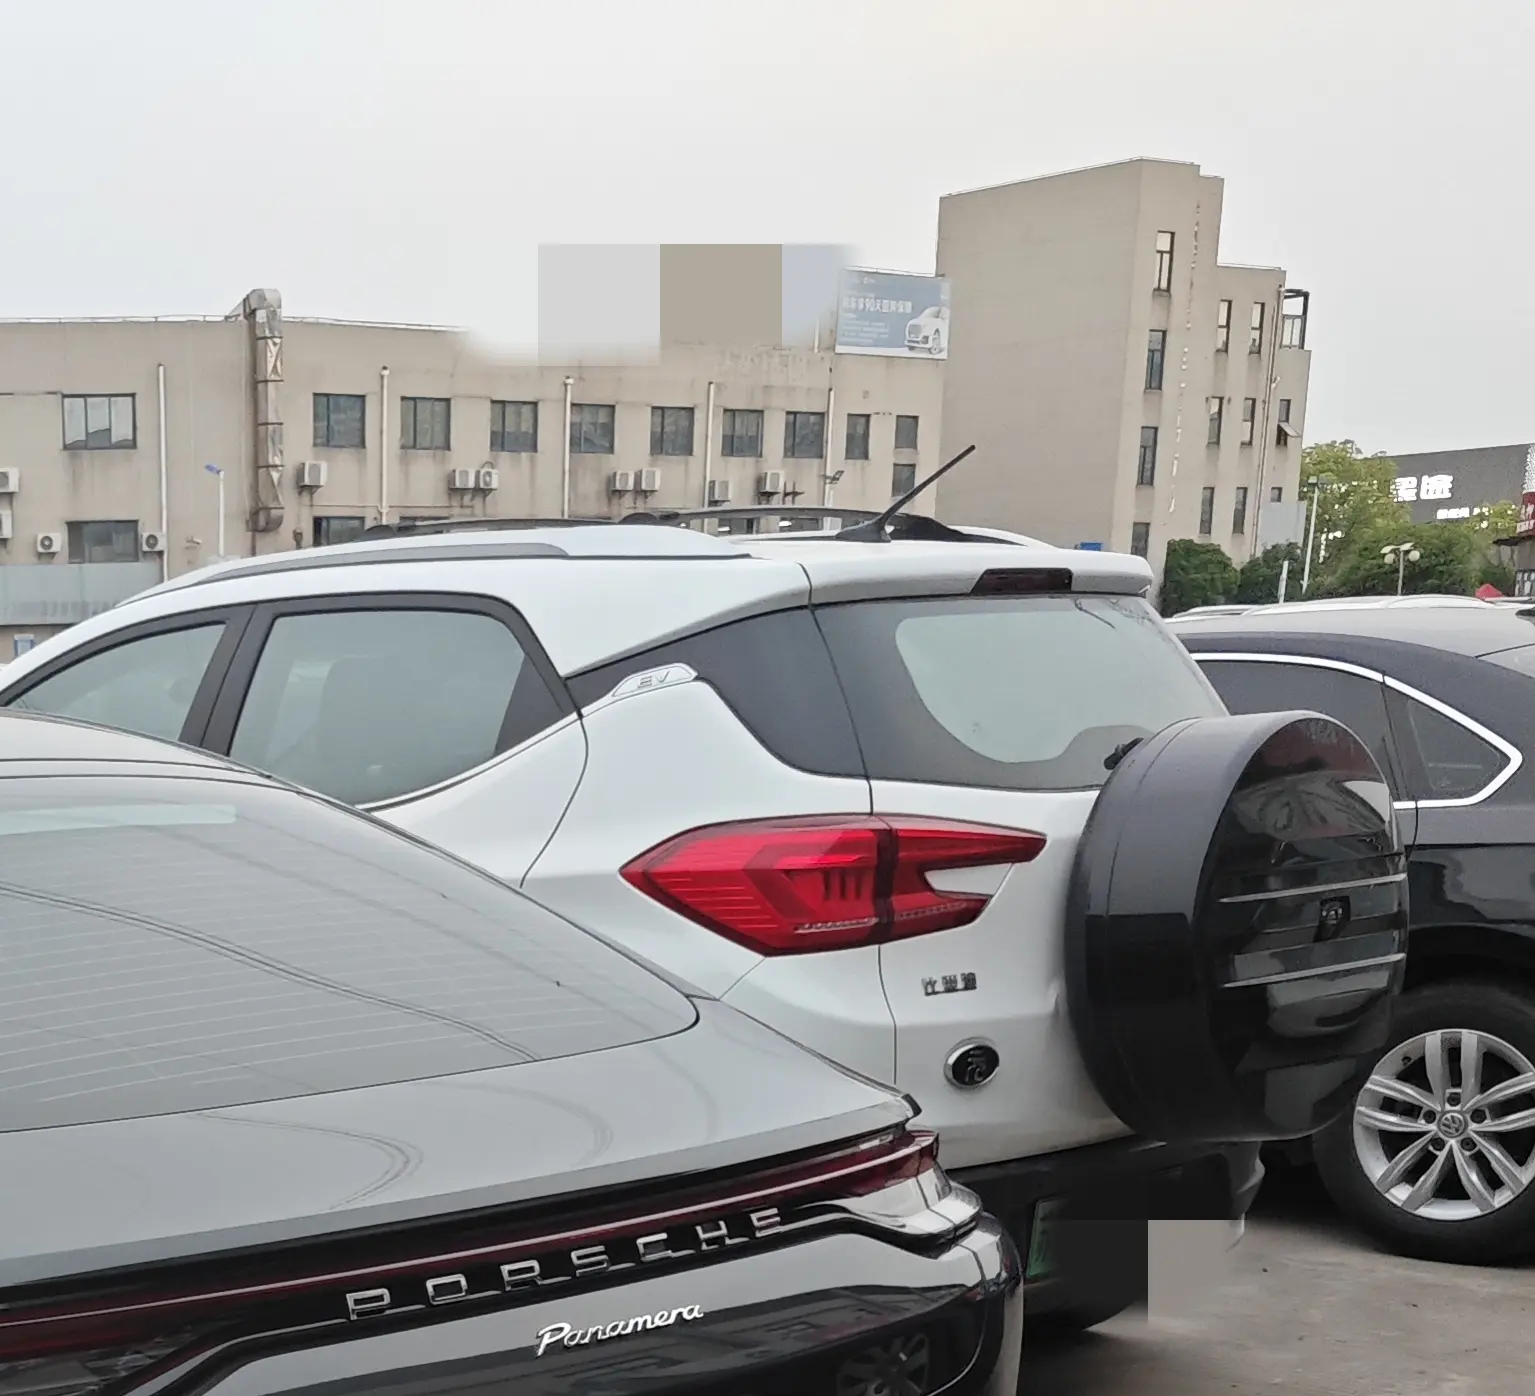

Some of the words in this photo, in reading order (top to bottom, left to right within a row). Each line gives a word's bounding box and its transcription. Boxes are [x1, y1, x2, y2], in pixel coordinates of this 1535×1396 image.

[637, 671, 670, 689] EV
[346, 1207, 781, 1321] PORSCHE
[537, 1304, 703, 1357] Panamera
